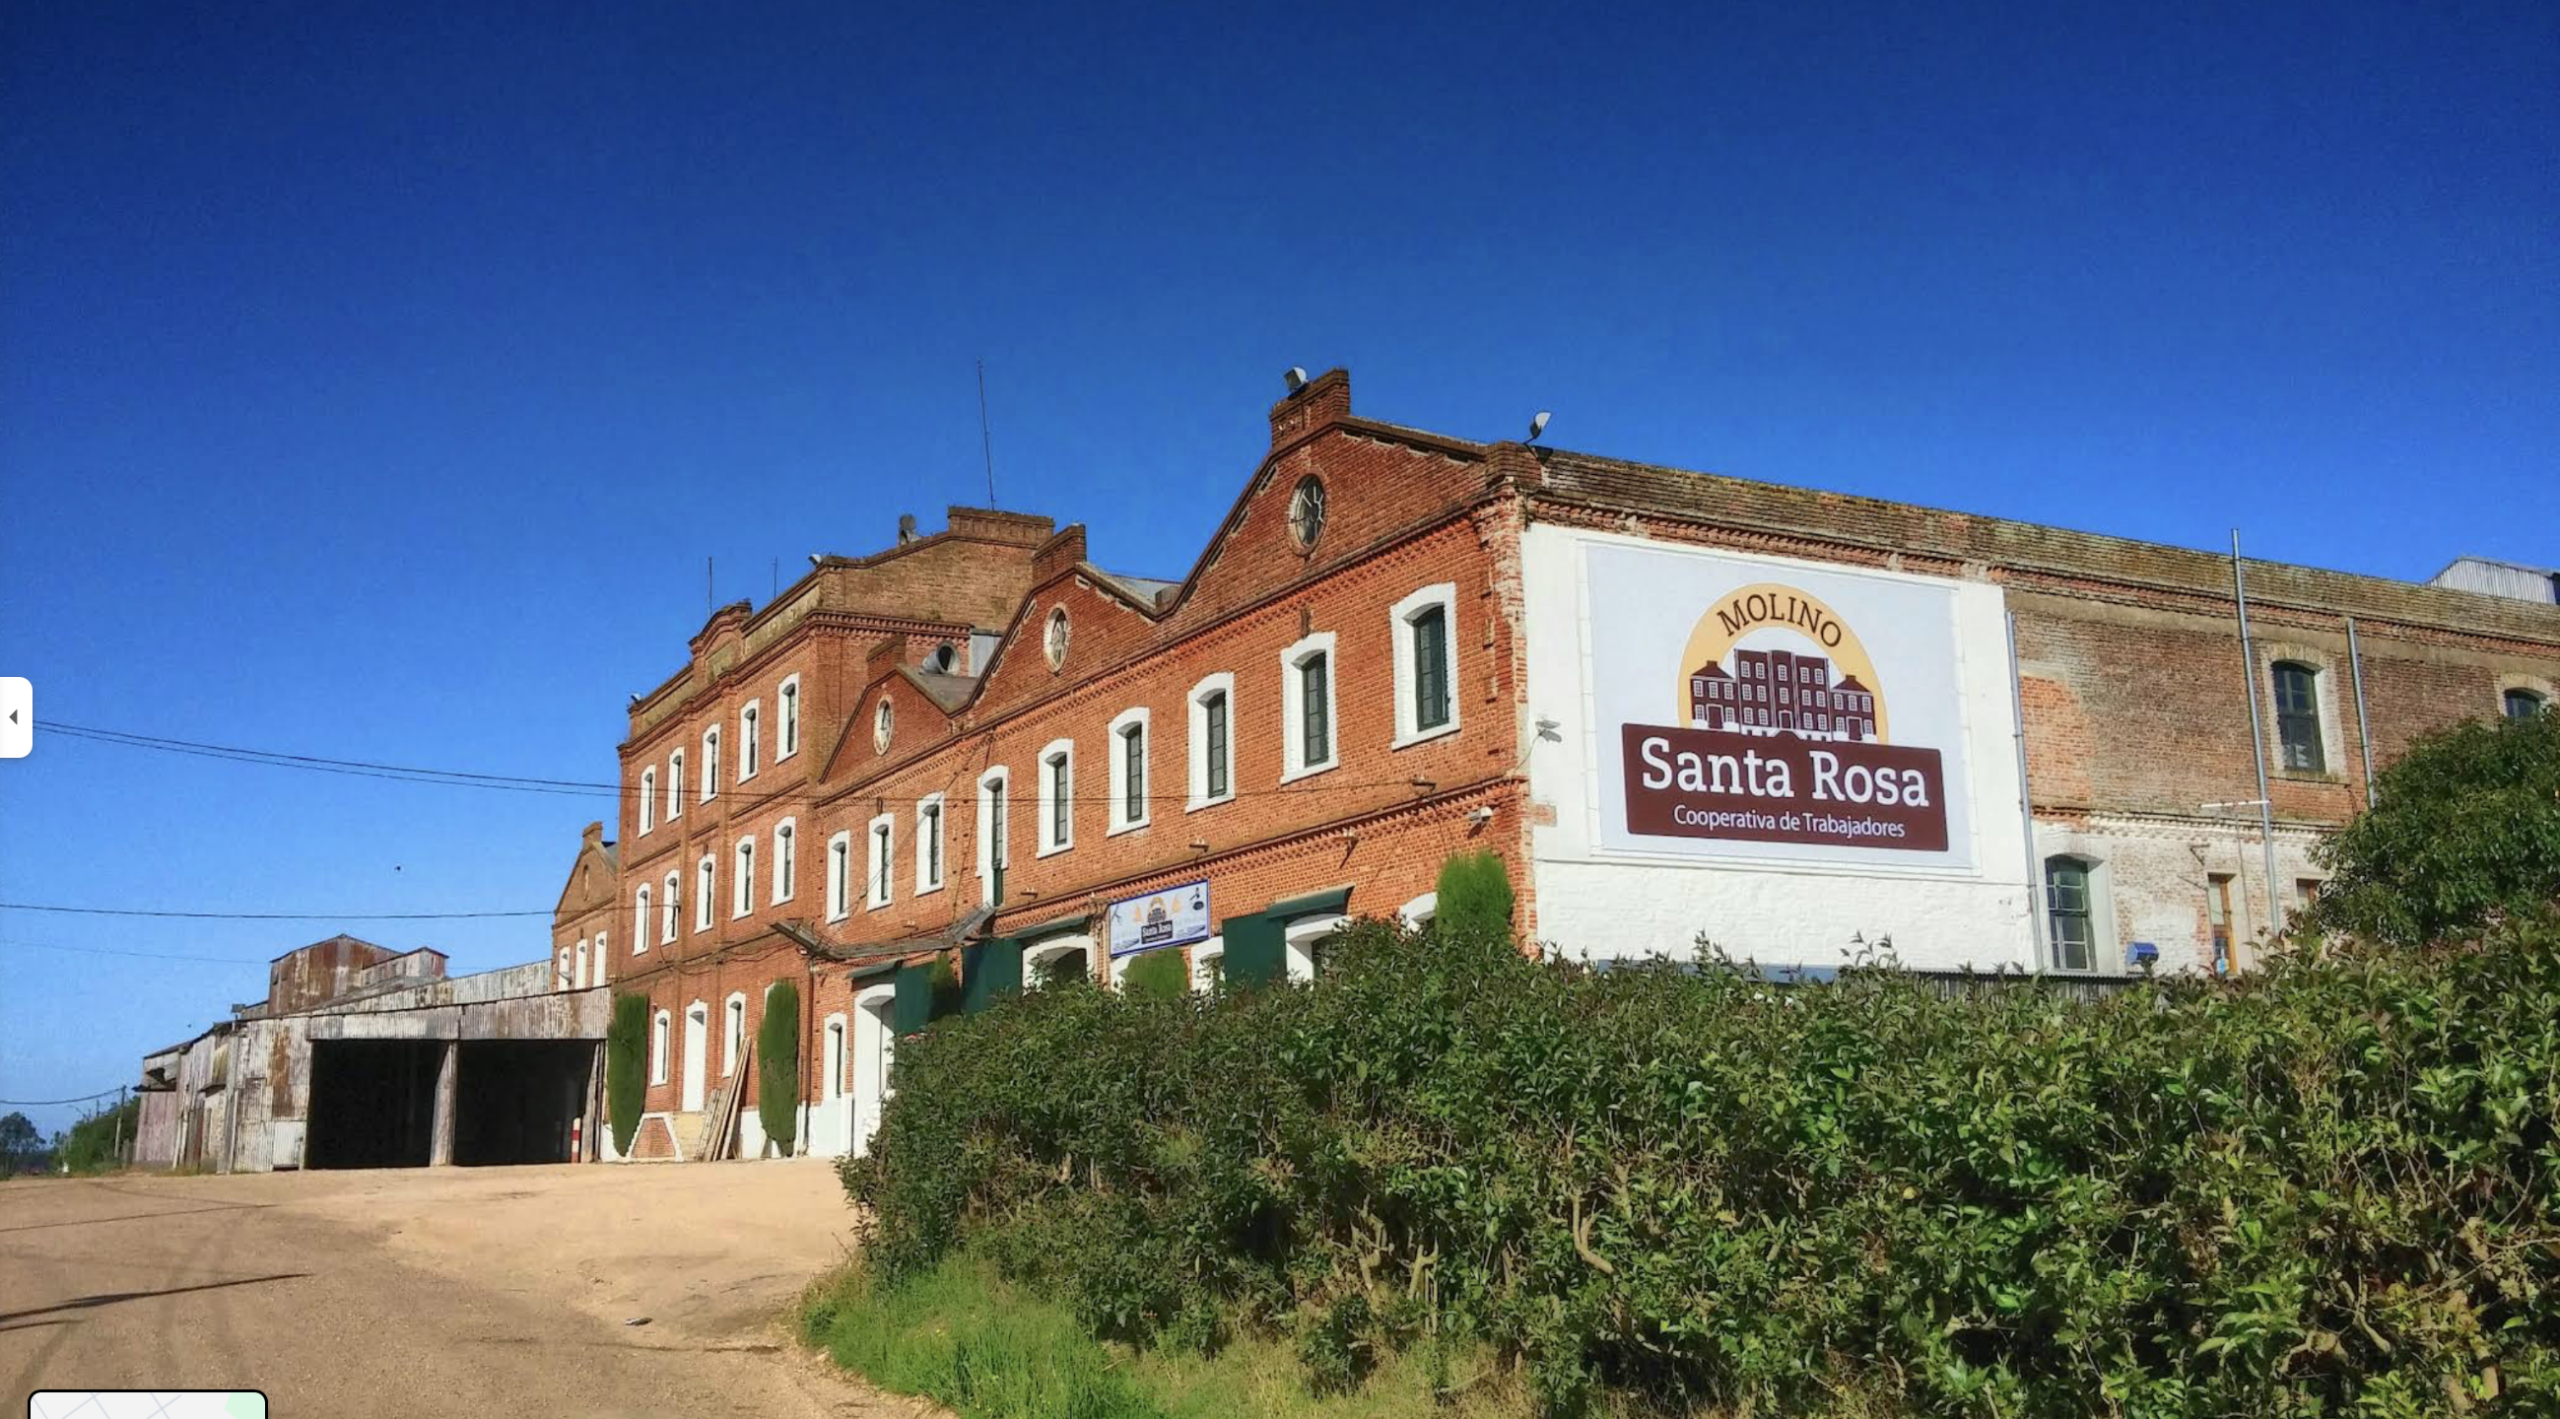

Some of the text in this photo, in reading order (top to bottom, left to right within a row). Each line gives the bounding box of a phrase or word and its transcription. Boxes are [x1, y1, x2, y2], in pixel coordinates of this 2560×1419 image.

[1716, 593, 1841, 647] MOLINO
[1641, 736, 1930, 808] Santa Rosa
[1674, 804, 1905, 839] Cooperativa de Trabajadores
